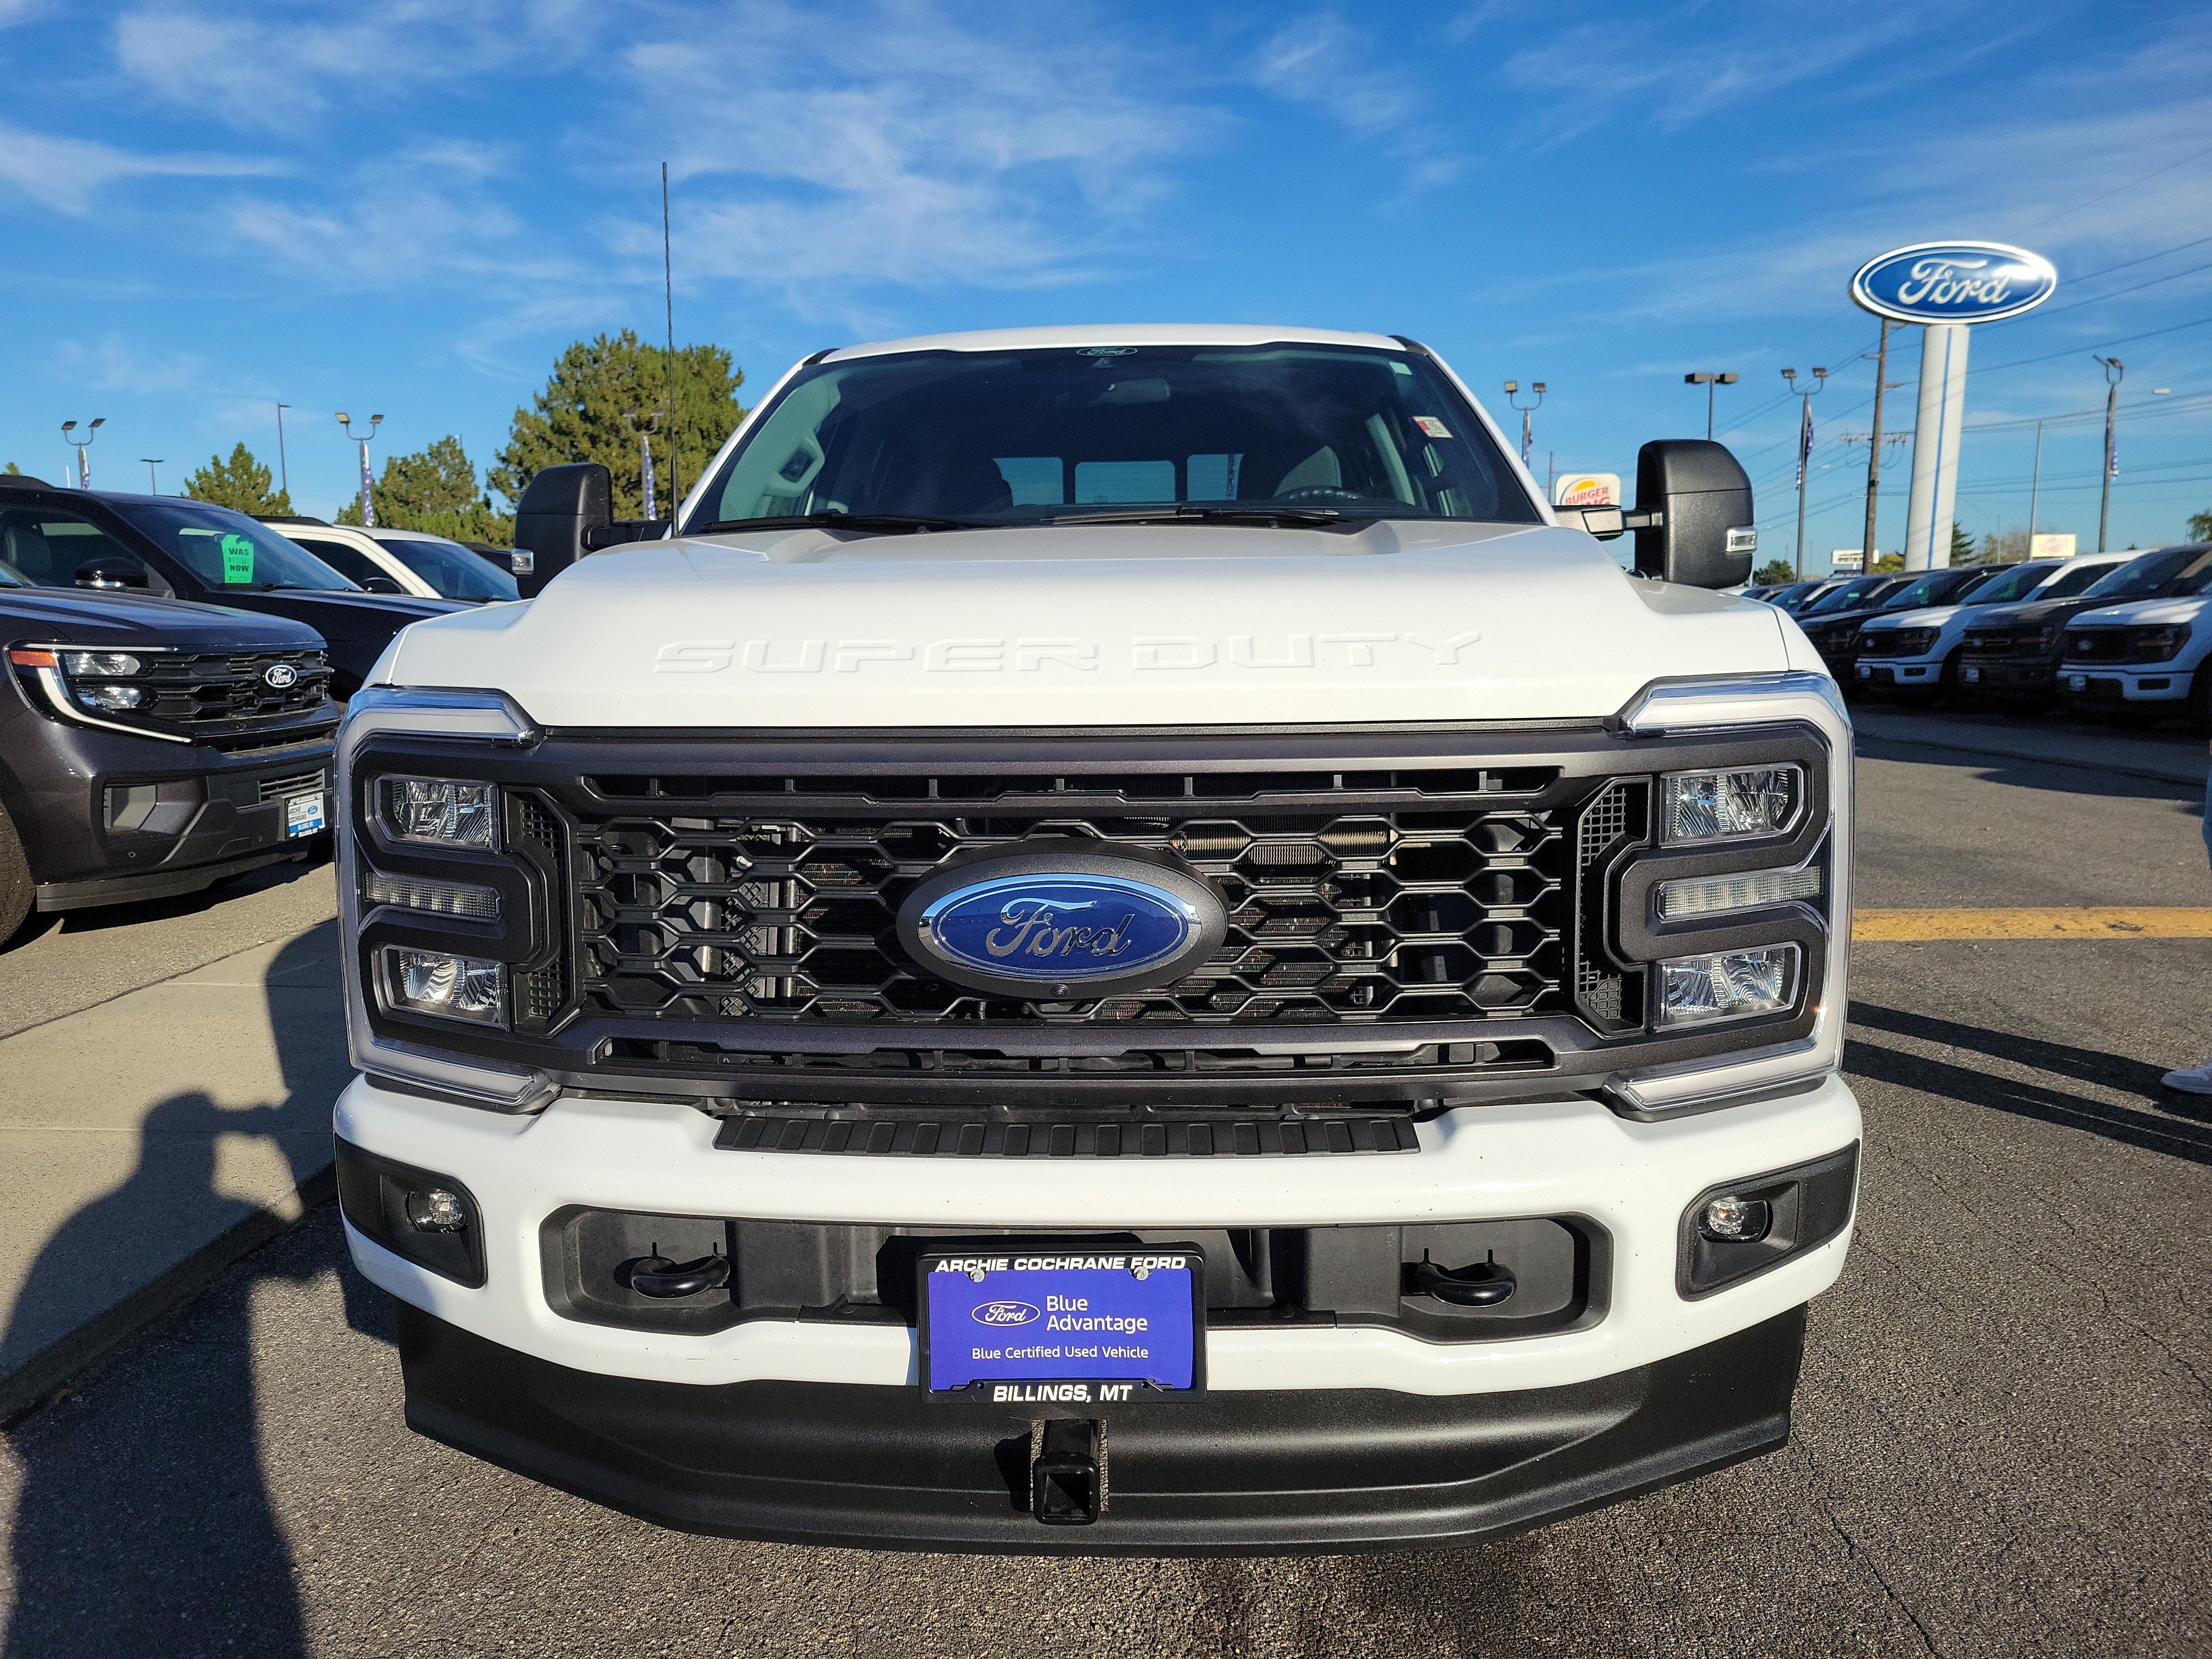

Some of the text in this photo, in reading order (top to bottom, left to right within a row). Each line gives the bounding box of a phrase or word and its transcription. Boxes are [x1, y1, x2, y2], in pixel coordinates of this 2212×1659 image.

[1898, 258, 2012, 305] Ford
[1565, 487, 1609, 505] BURGER
[653, 632, 1482, 673] SUPER DUTY
[272, 668, 292, 684] Ford
[985, 898, 1136, 957] Ford
[934, 1256, 1186, 1273] ARCHIE COCHRANE FORD
[1046, 1295, 1088, 1312] Blue
[985, 1304, 1028, 1322] Ford
[1046, 1314, 1148, 1335] Advantage
[972, 1345, 1149, 1359] Blue Certified Used Vehicle
[993, 1384, 1133, 1403] BILLINGS, MT
